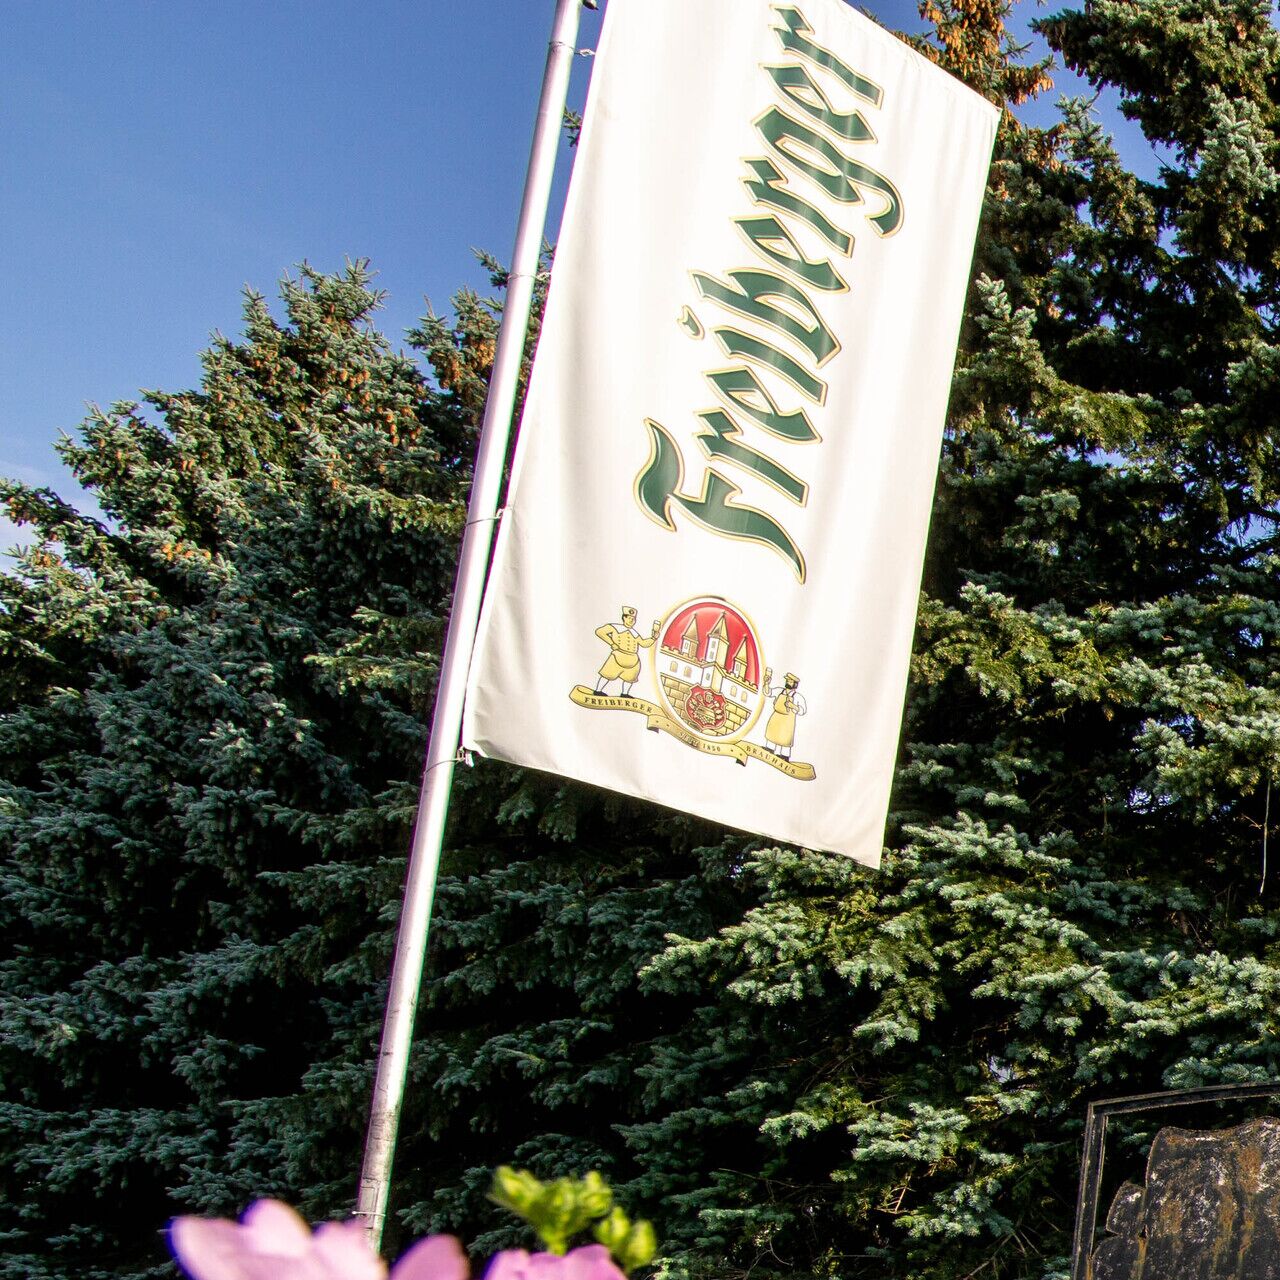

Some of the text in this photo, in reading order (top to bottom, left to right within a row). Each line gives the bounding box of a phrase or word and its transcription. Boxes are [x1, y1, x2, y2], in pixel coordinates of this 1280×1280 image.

[632, 4, 904, 585] Freiberger
[584, 696, 796, 775] FREIBERGER 1850 BRAUHAUS
